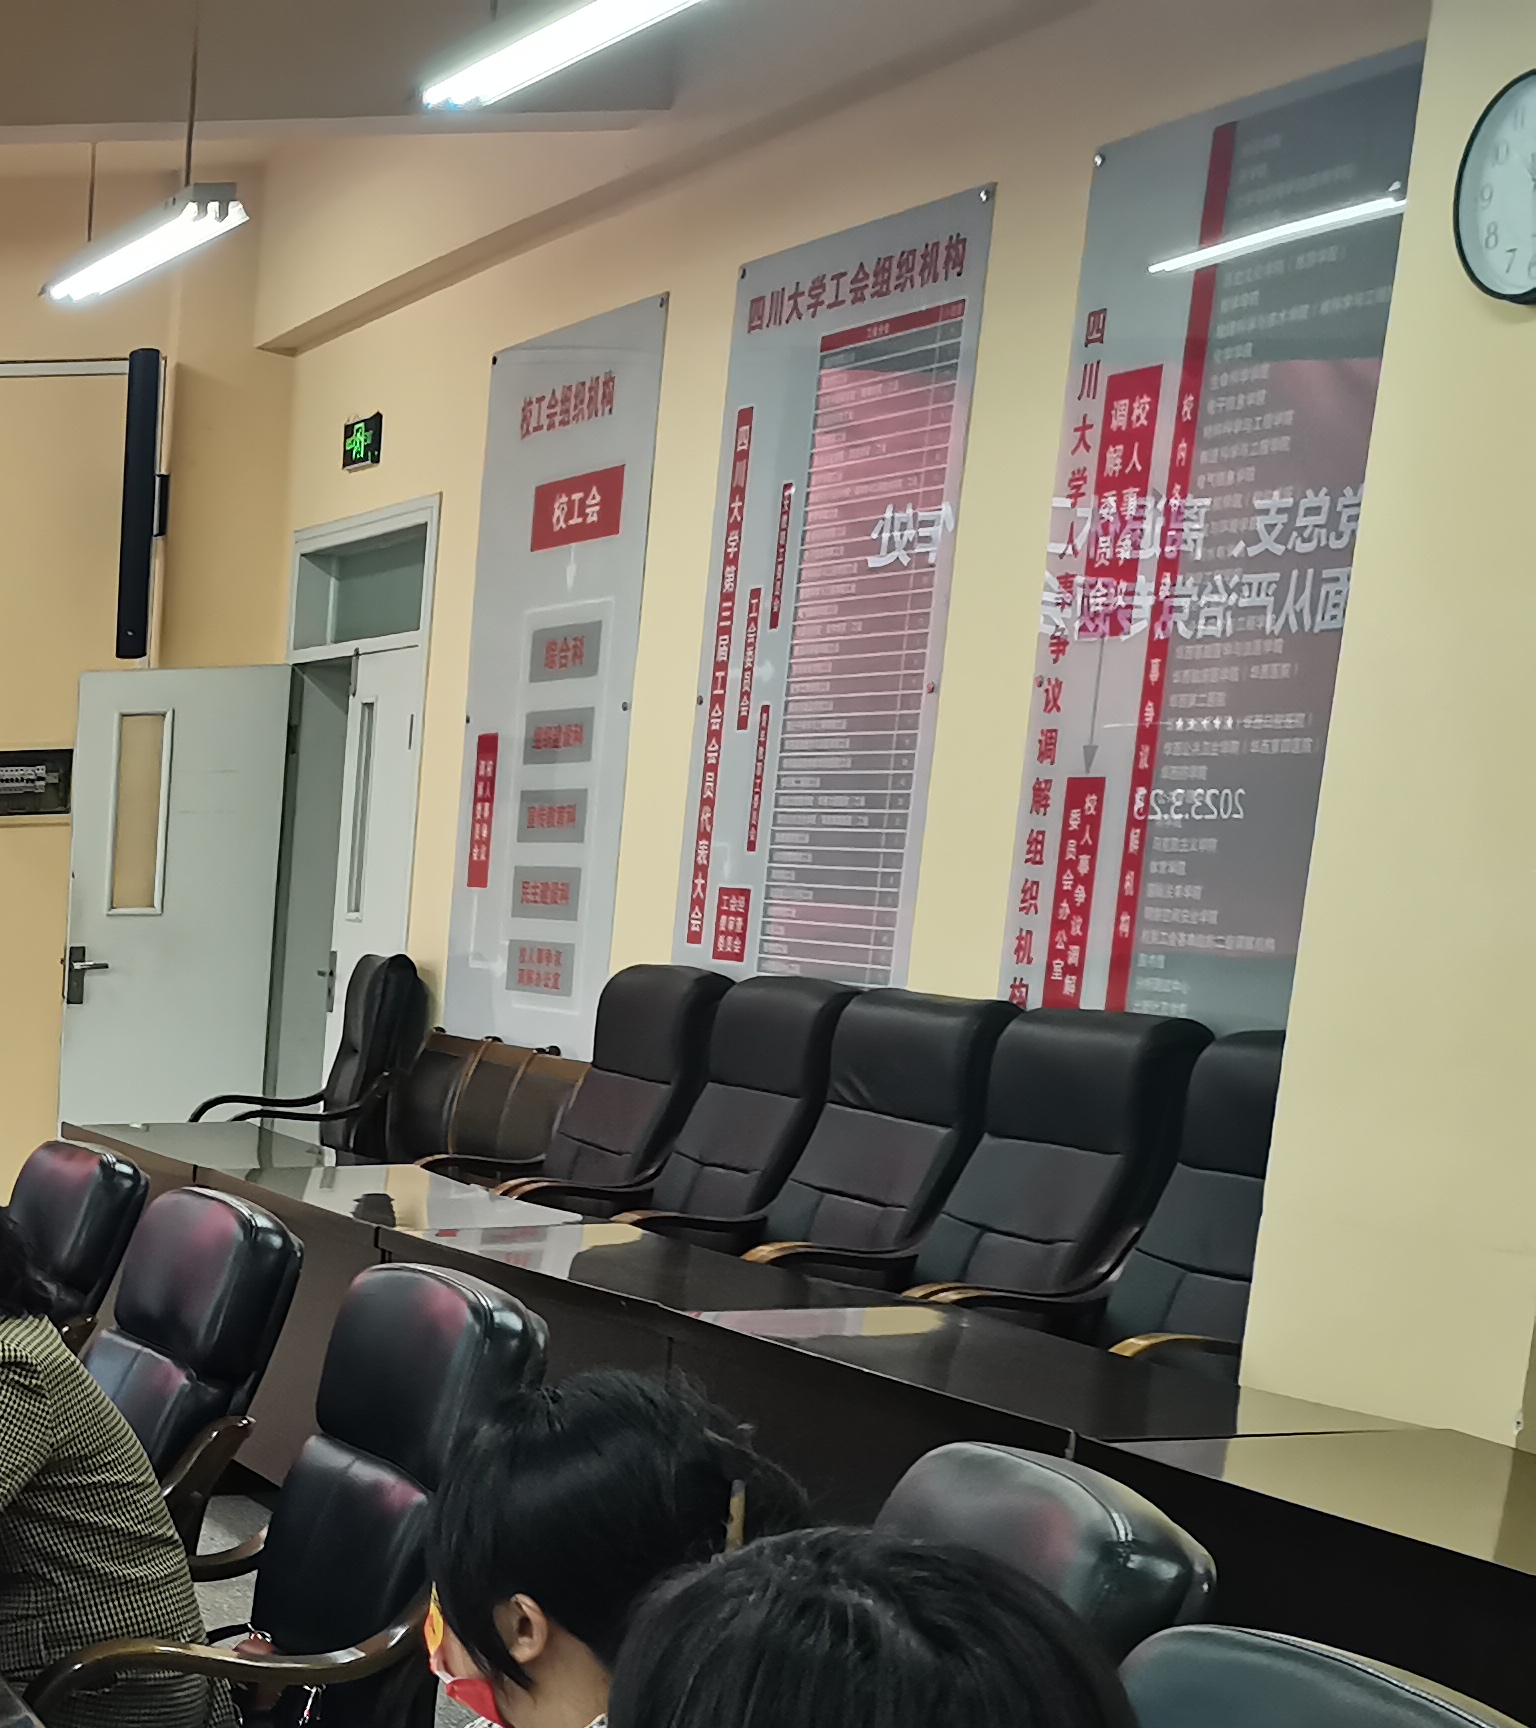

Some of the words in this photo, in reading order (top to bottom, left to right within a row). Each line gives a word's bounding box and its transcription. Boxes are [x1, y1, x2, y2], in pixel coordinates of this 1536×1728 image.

[747, 232, 967, 335] 四川大学工会组织机构
[519, 369, 616, 441] 校工会组织机构
[551, 484, 602, 533] 校工会
